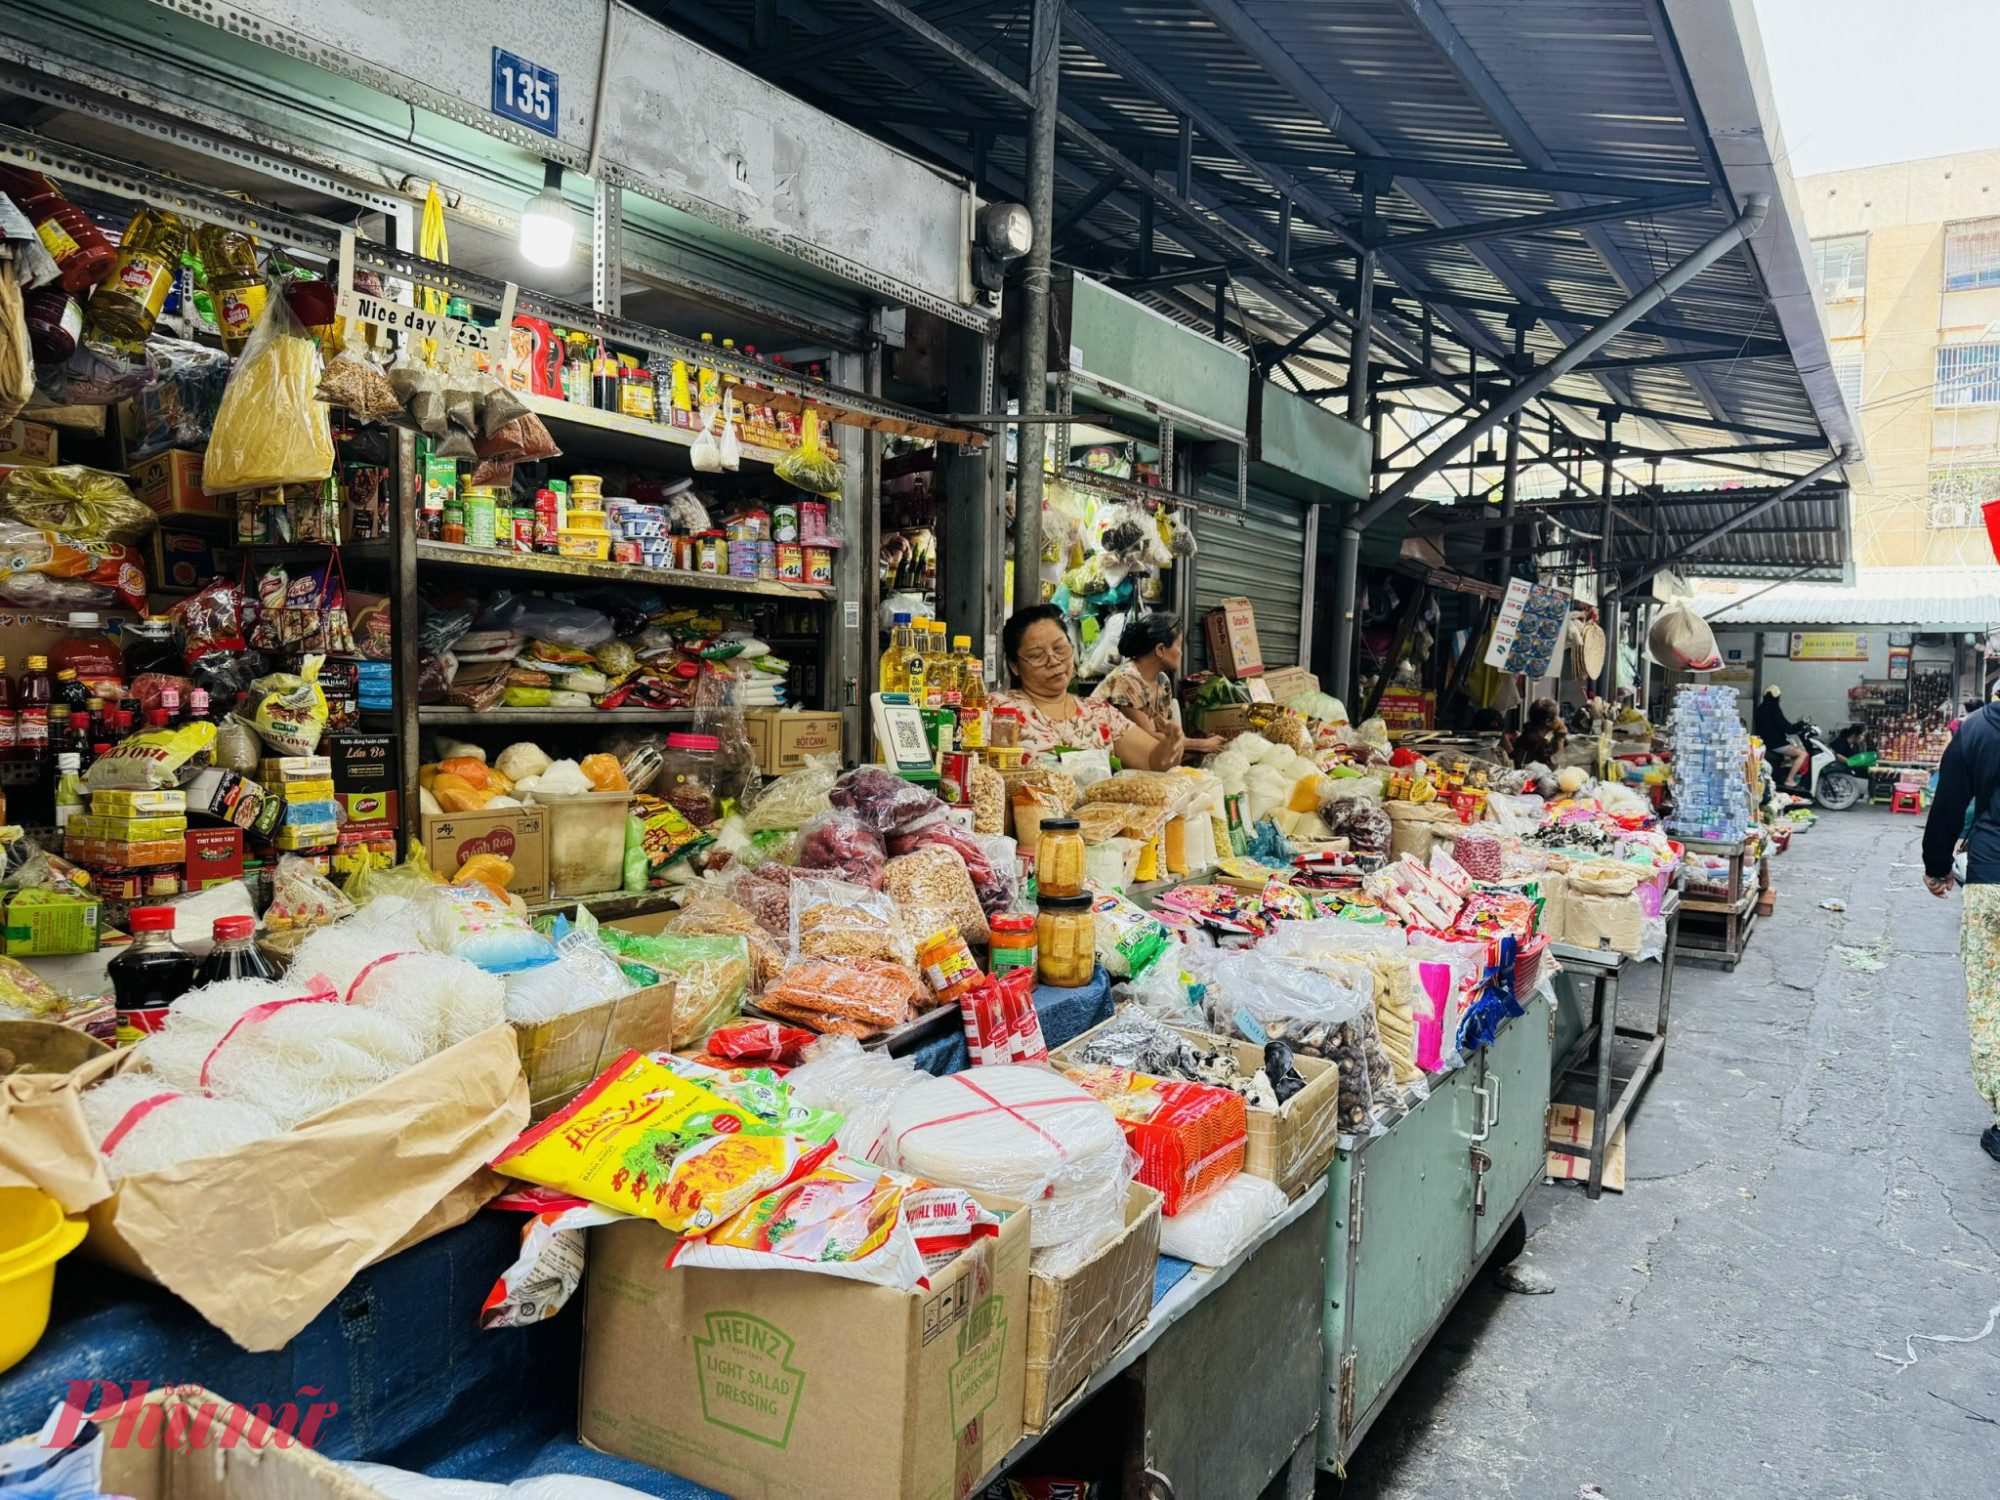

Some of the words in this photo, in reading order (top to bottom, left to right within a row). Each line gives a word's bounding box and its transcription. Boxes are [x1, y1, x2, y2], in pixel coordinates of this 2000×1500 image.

[501, 66, 551, 121] 135
[358, 298, 398, 325] Nice
[404, 310, 437, 337] day
[492, 836, 513, 851] Rán
[932, 1201, 958, 1219] VĨNH
[717, 1319, 782, 1360] HEINZ
[706, 1355, 745, 1381] LIGHT
[747, 1368, 790, 1396] SALAD
[956, 1355, 978, 1389] LIGHT
[961, 1363, 994, 1408] DRESSING
[715, 1380, 778, 1416] DRESSING
